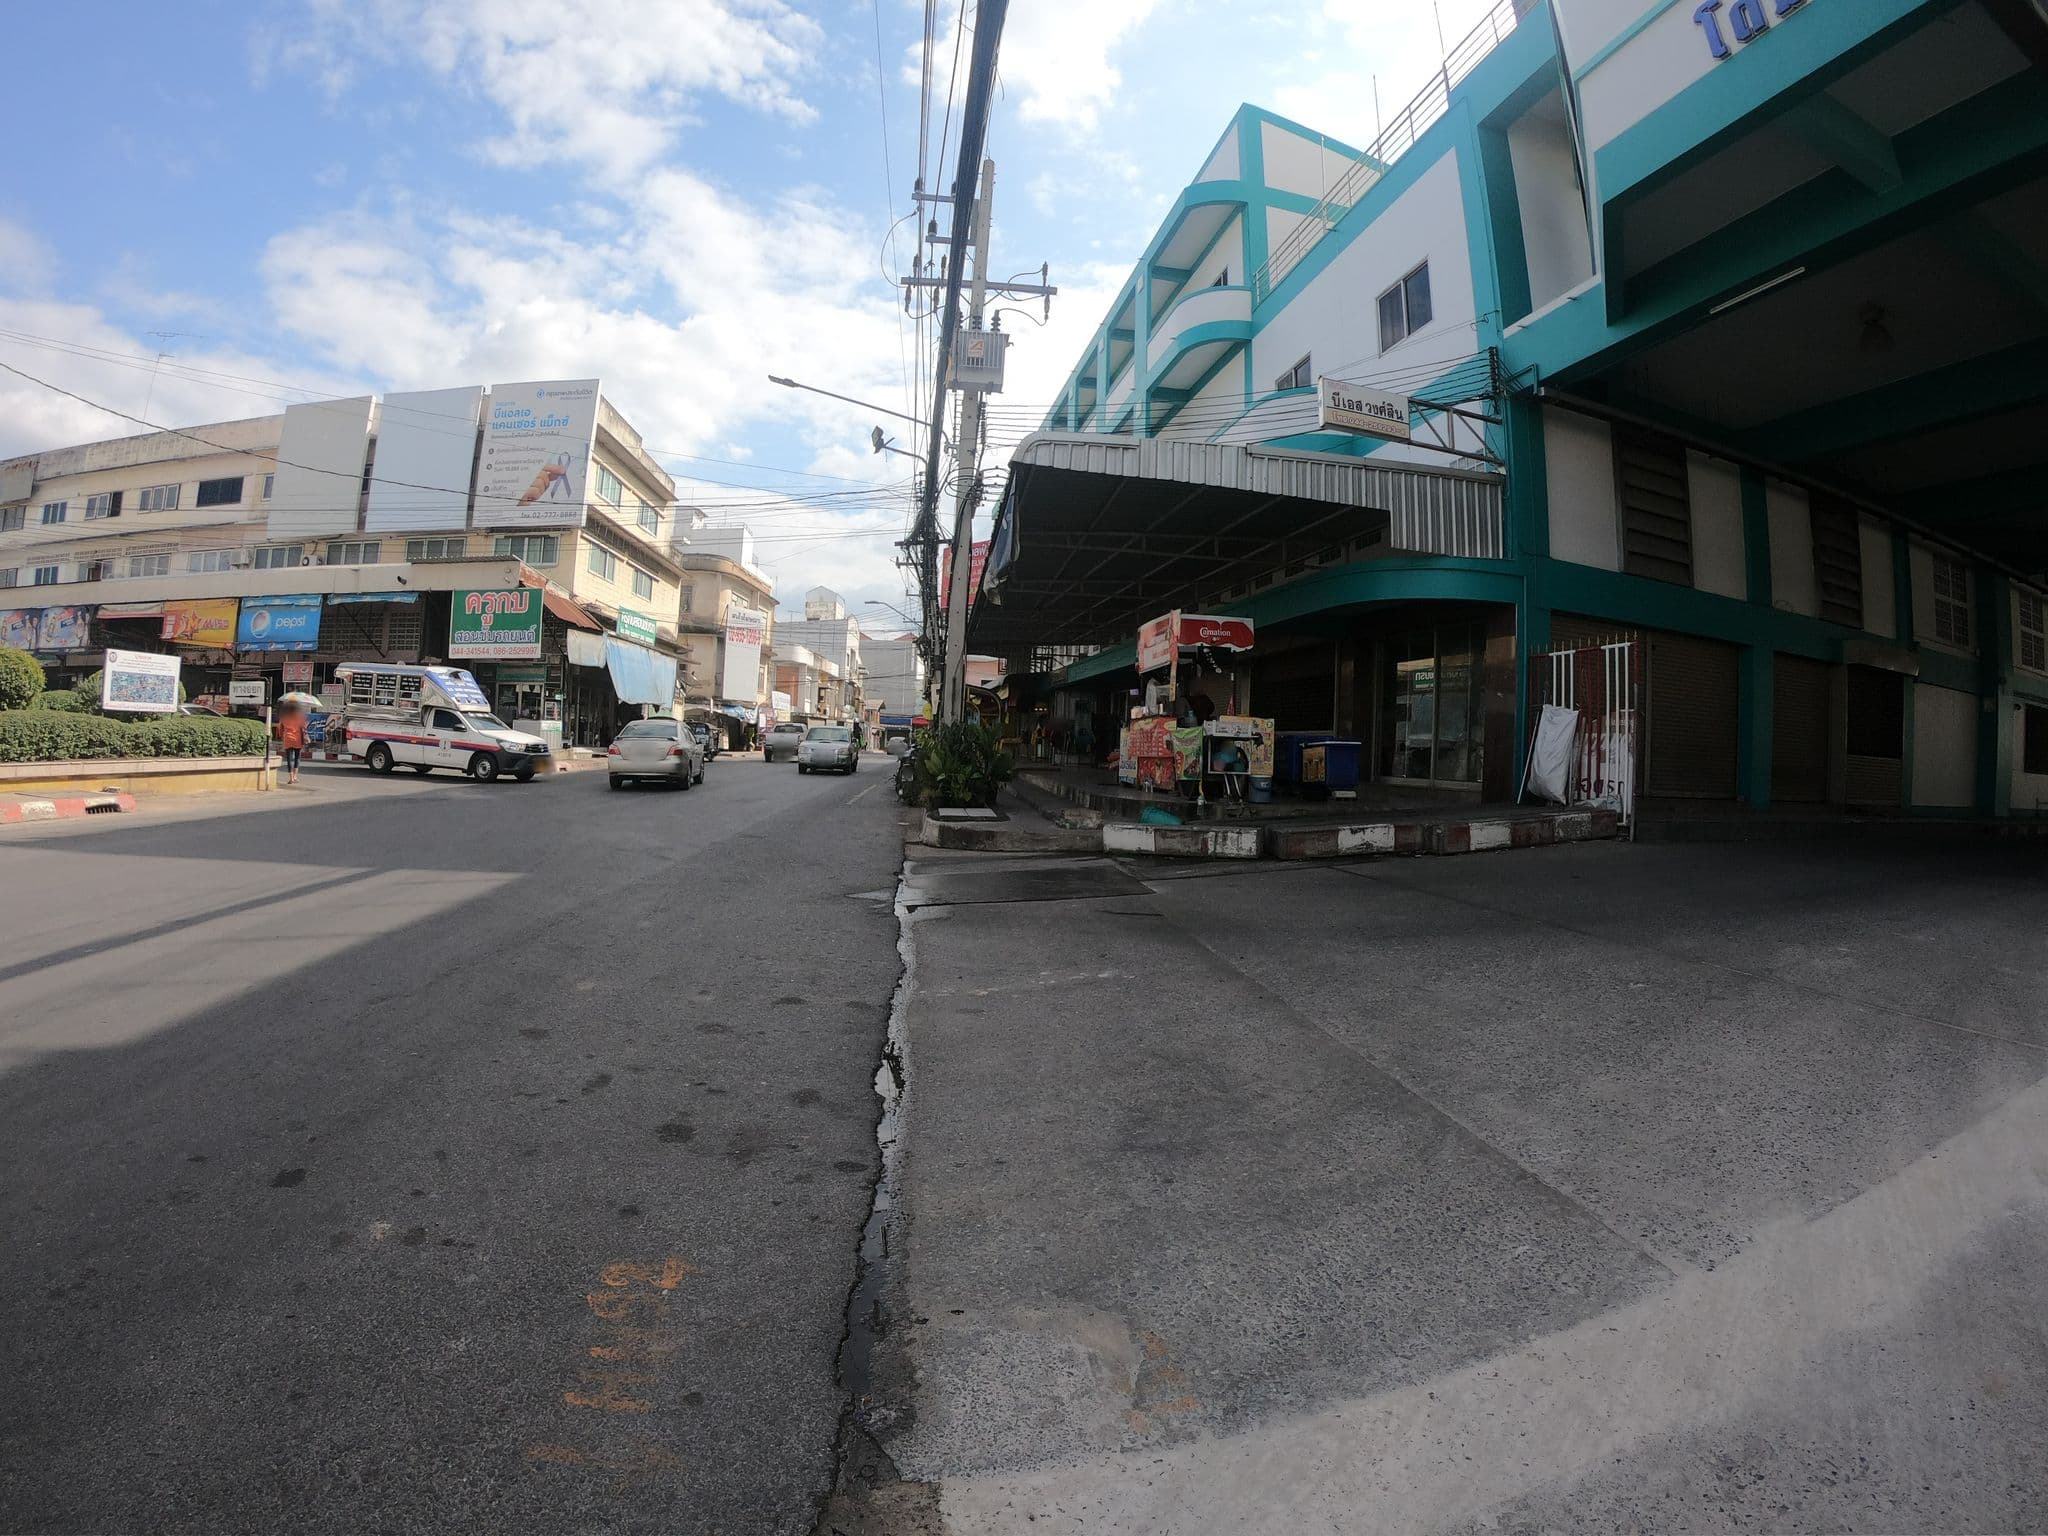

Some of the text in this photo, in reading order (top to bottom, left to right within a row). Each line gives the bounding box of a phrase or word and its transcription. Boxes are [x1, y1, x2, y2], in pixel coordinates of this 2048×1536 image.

[495, 407, 531, 419] บีแอลเอ
[1365, 401, 1404, 421] วงศ์สิน
[492, 413, 570, 430] แคนเซอร์ แม็กซ์
[465, 591, 530, 627] ครูกบ
[275, 616, 306, 630] pepsi
[455, 624, 537, 643] สอนขับรถยนต์
